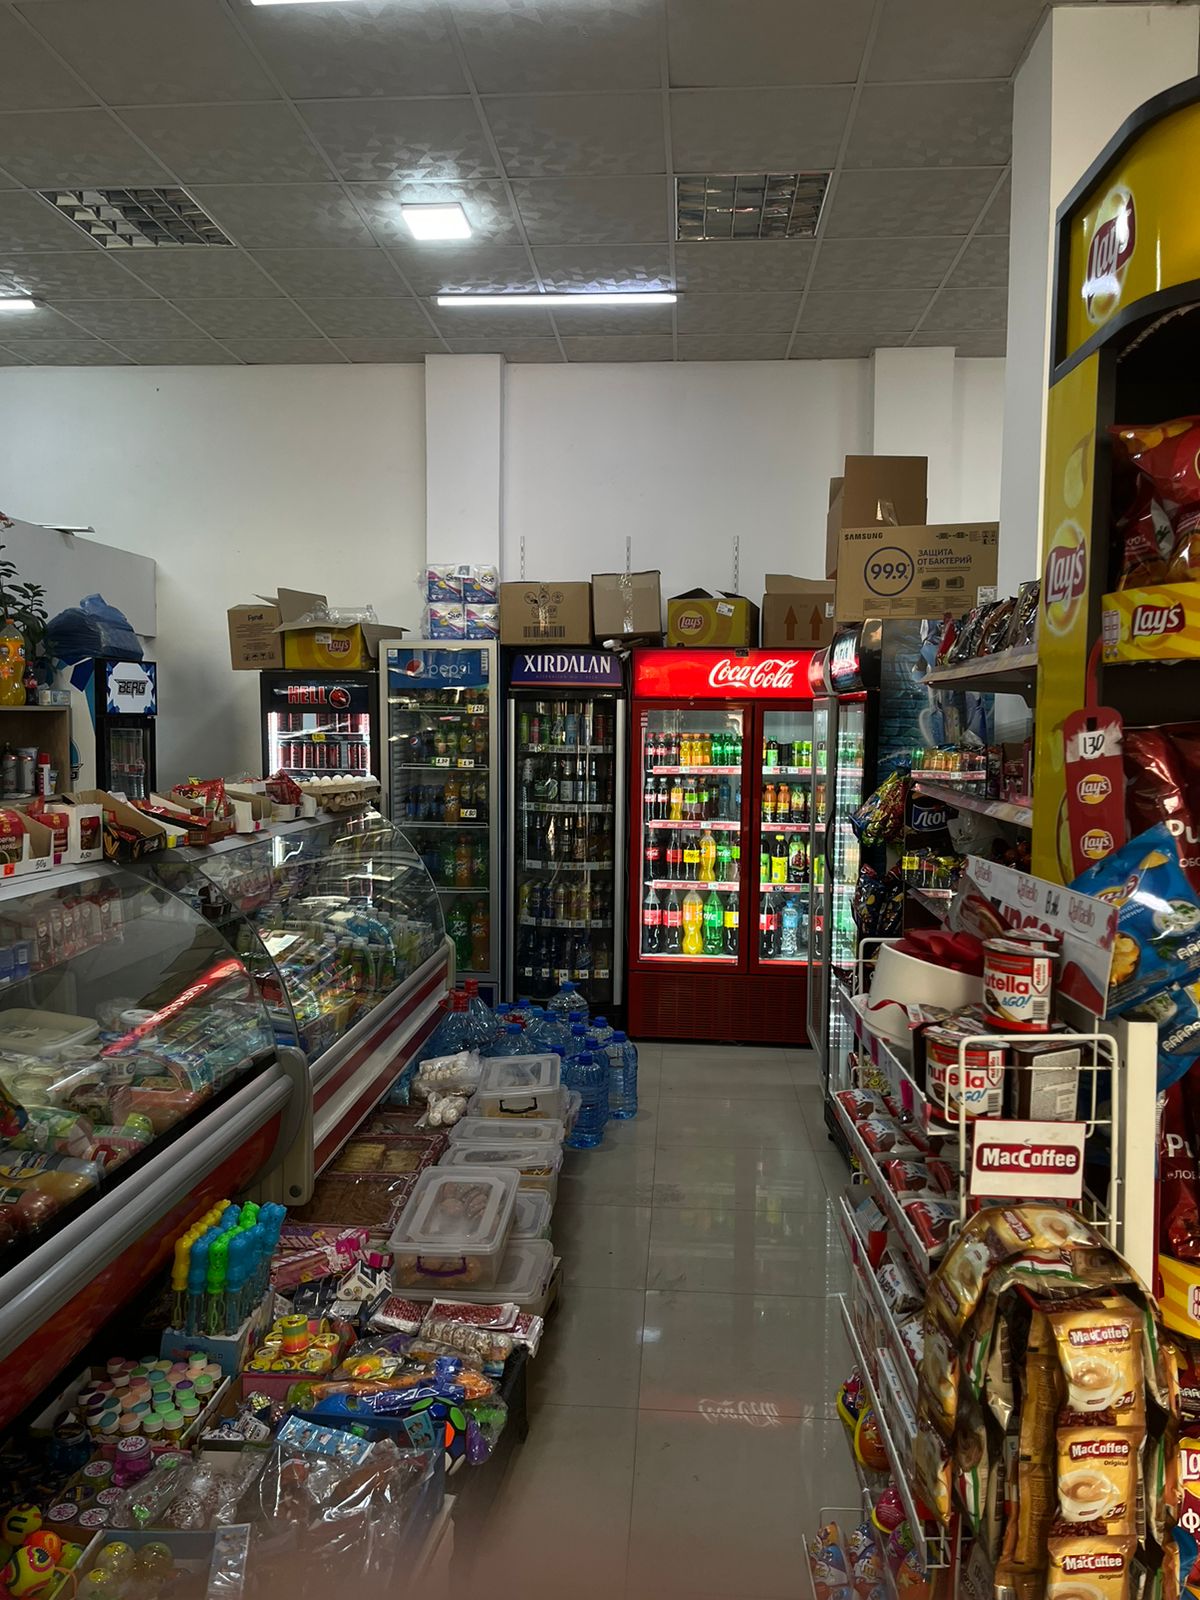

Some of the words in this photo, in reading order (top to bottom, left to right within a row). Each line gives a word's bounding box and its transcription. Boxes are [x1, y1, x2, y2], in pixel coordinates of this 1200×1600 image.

[844, 532, 884, 541] SAMSUNG
[917, 558, 928, 566] ОТ
[928, 555, 972, 566] БАКТЕРИЙ
[918, 549, 953, 557] ЗАЩИТА
[1047, 543, 1085, 611] Lay's
[1133, 602, 1181, 636] Lay's
[427, 662, 470, 684] pepsi
[523, 655, 611, 673] XIRDALAN
[708, 659, 800, 688] Coca-Cola
[114, 678, 149, 698] BERG
[287, 685, 328, 704] HELL
[1081, 778, 1109, 797] Lay's
[1083, 834, 1110, 852] Lay's
[984, 972, 1029, 994] utella
[928, 1064, 985, 1088] nutela
[982, 1148, 1076, 1168] MacCoffee
[1070, 1327, 1129, 1344] MacCoffee
[1072, 1442, 1129, 1457] MacCoffee
[1065, 1556, 1122, 1570] MacCoffee
